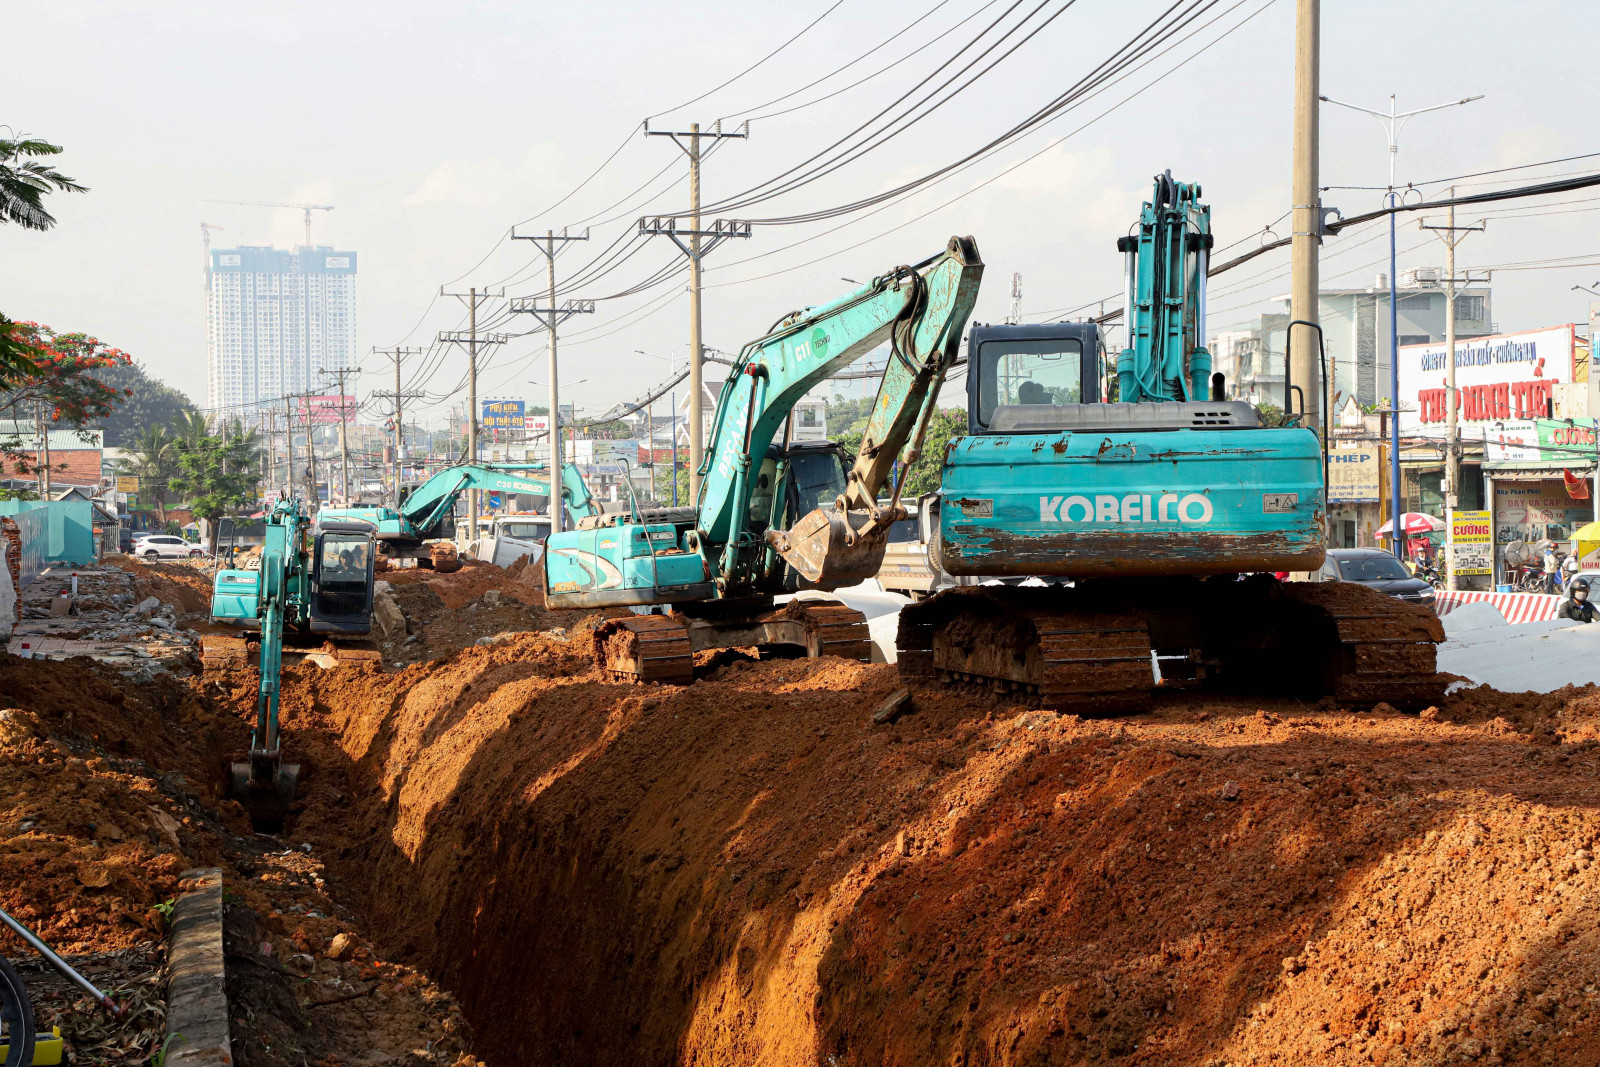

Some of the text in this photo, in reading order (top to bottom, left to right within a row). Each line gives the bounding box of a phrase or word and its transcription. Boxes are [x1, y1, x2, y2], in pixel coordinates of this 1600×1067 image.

[795, 341, 810, 362] C11
[1463, 382, 1511, 421] MINH
[513, 481, 543, 493] KOBELCO
[1039, 493, 1213, 525] KOBELCO
[1453, 522, 1489, 536] CƯỜNG
